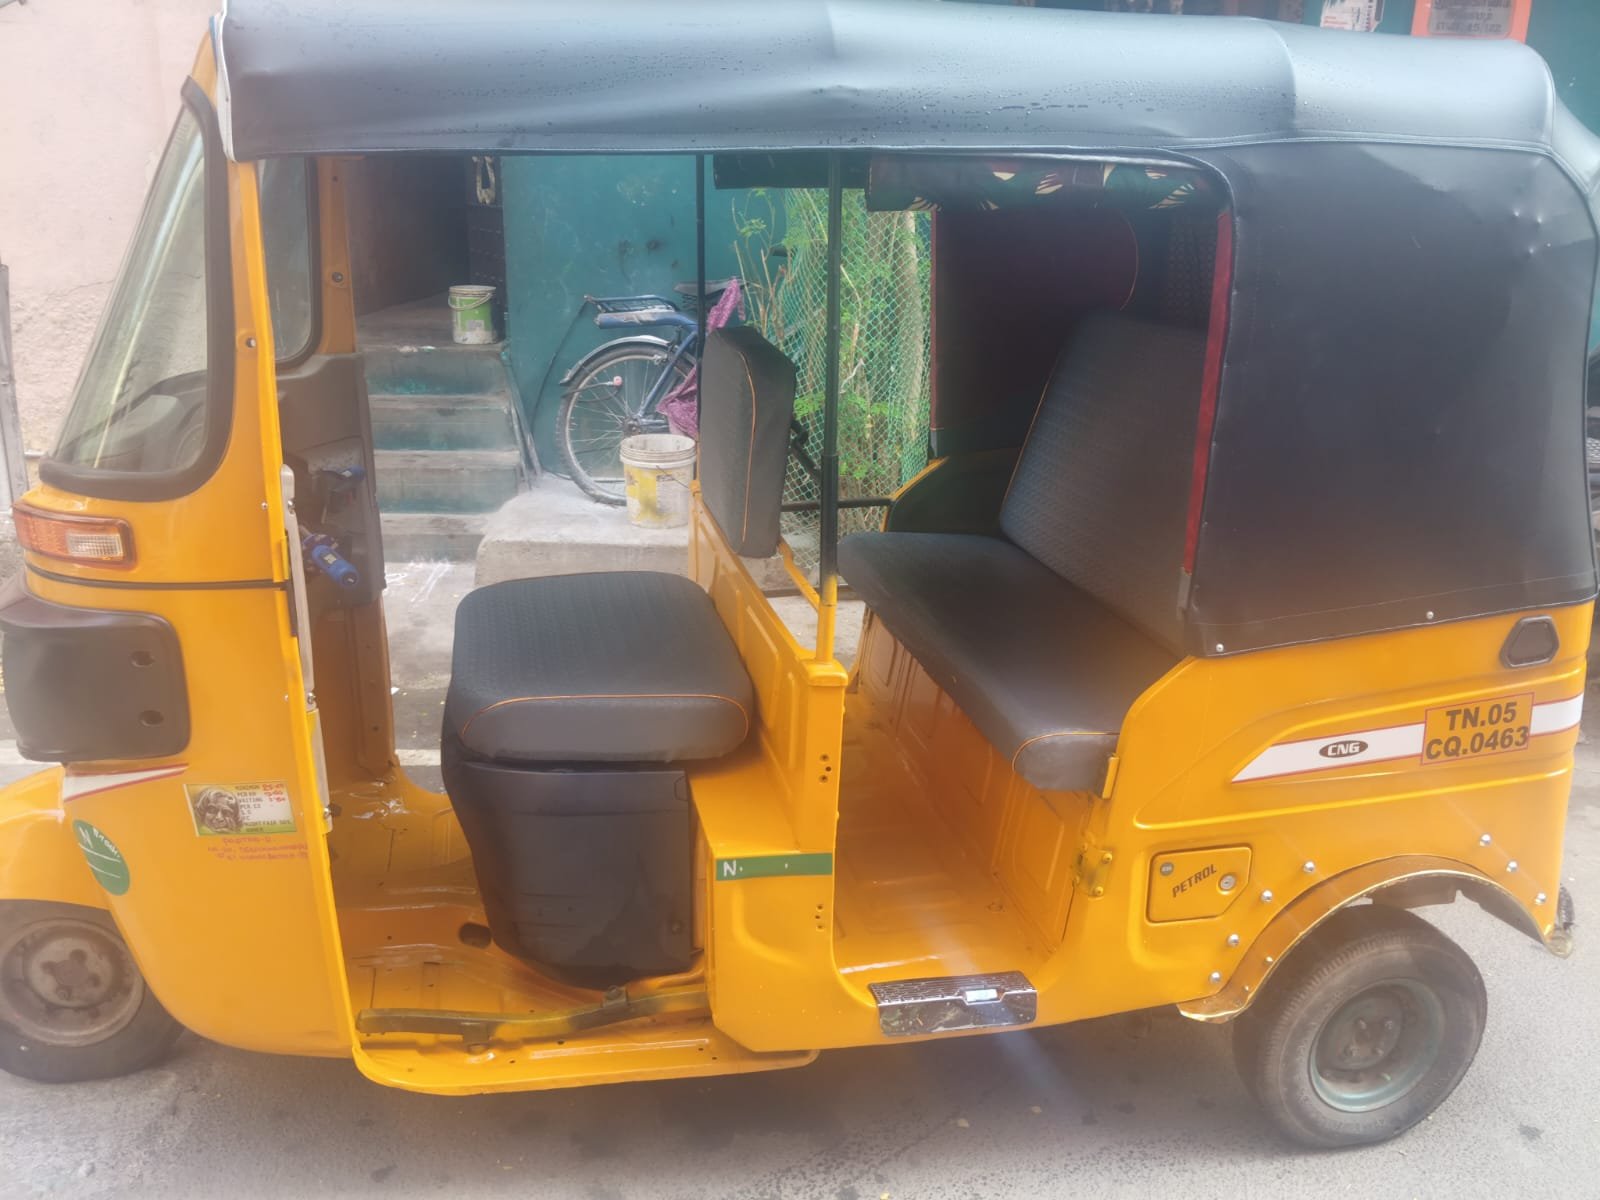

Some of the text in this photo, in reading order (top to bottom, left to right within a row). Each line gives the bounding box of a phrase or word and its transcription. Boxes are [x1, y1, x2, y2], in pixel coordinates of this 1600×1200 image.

[1446, 701, 1517, 731] TN.05
[1327, 743, 1360, 756] CNG
[1426, 726, 1528, 759] CQ.0463
[1172, 864, 1216, 897] PETROL
